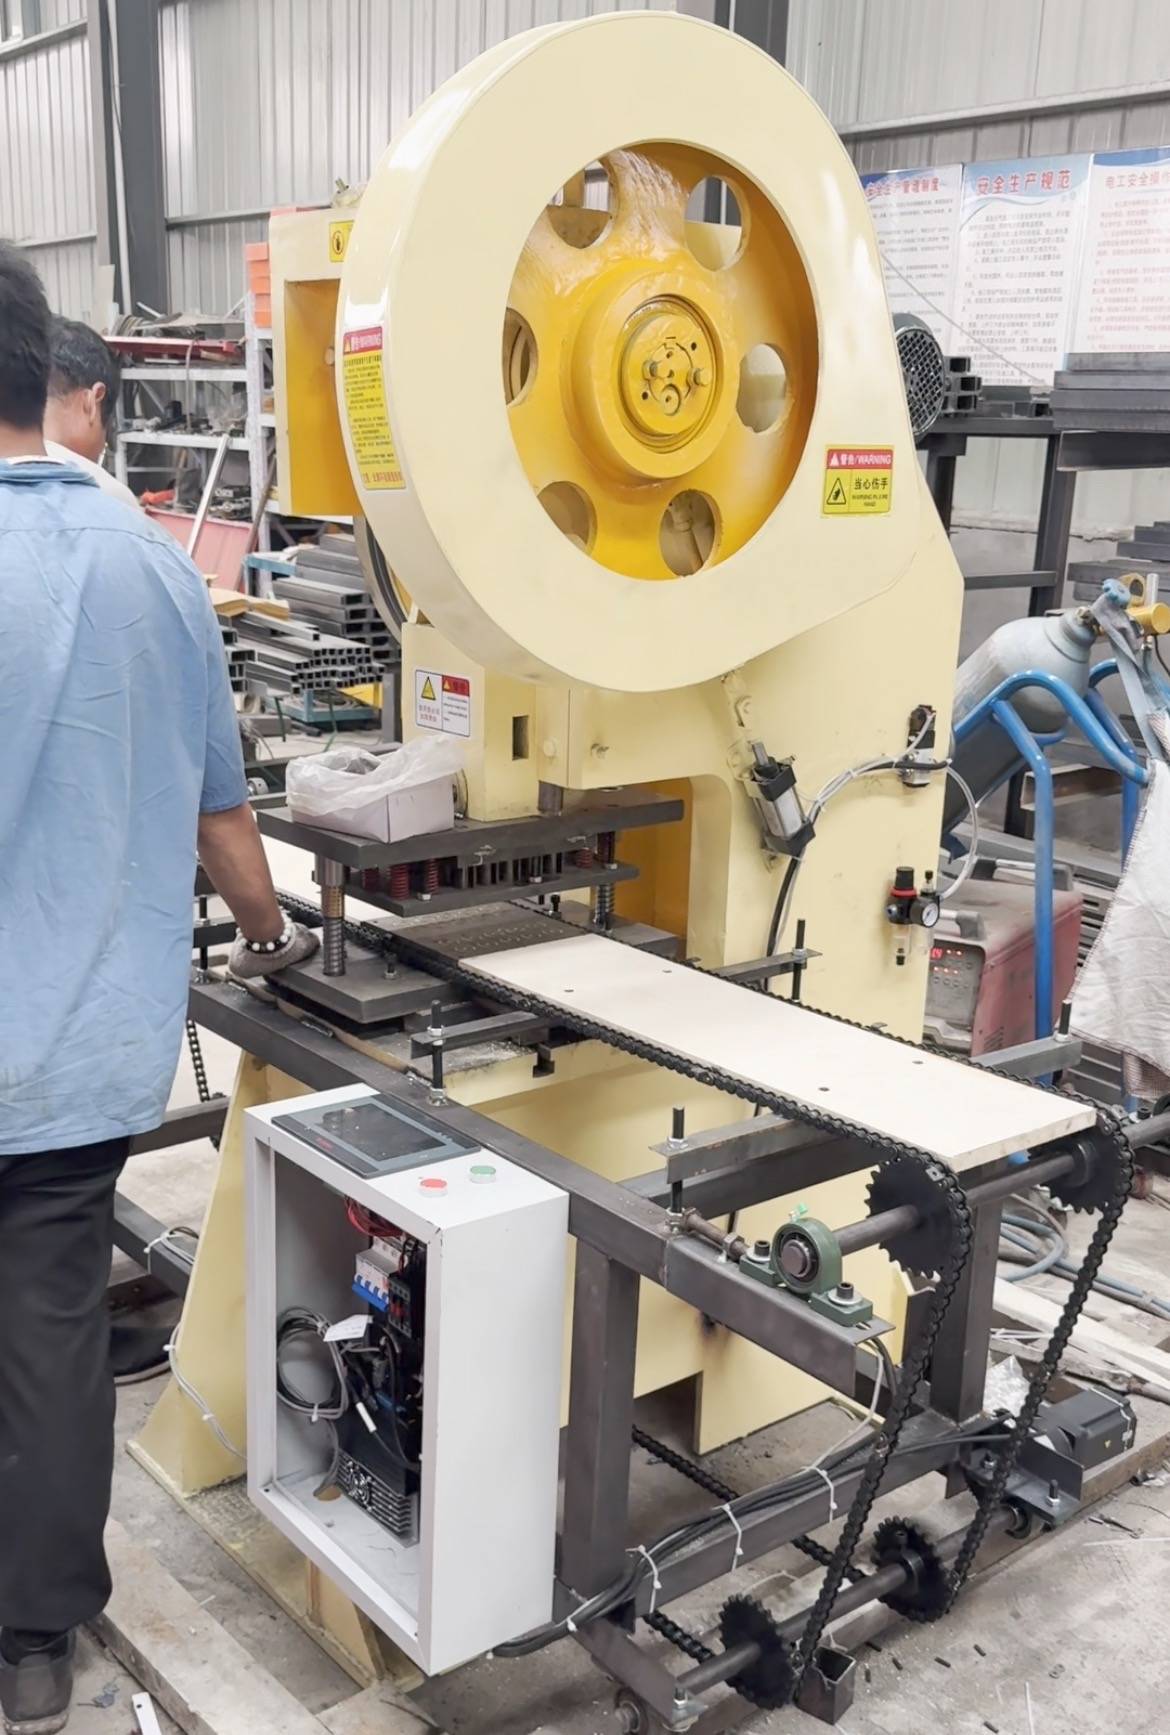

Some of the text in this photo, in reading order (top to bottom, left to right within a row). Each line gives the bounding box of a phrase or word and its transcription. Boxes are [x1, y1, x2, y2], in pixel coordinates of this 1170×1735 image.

[976, 169, 1072, 196] 安全生产规范
[854, 476, 889, 490] 当心伤手
